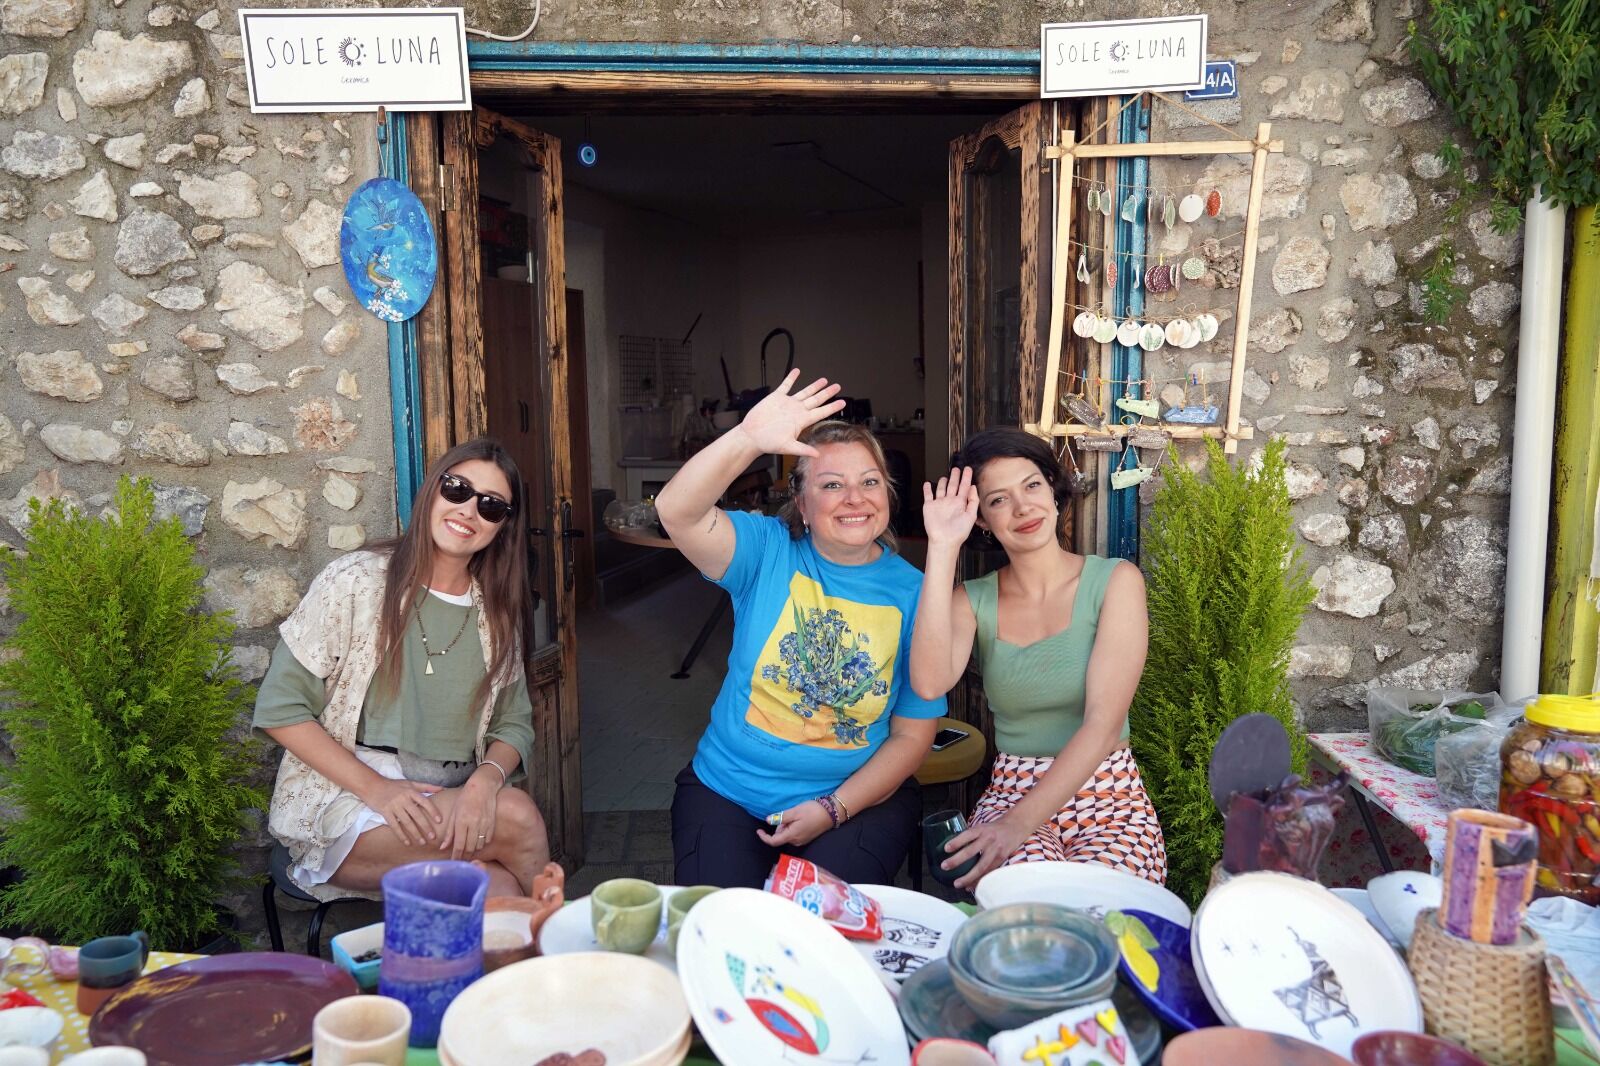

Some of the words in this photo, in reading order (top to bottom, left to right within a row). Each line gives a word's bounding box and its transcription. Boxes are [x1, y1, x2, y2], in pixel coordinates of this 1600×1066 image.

[266, 37, 328, 68] SOLE
[376, 36, 441, 65] LUNA
[1056, 41, 1101, 66] SOLE
[1137, 36, 1186, 60] LUNA
